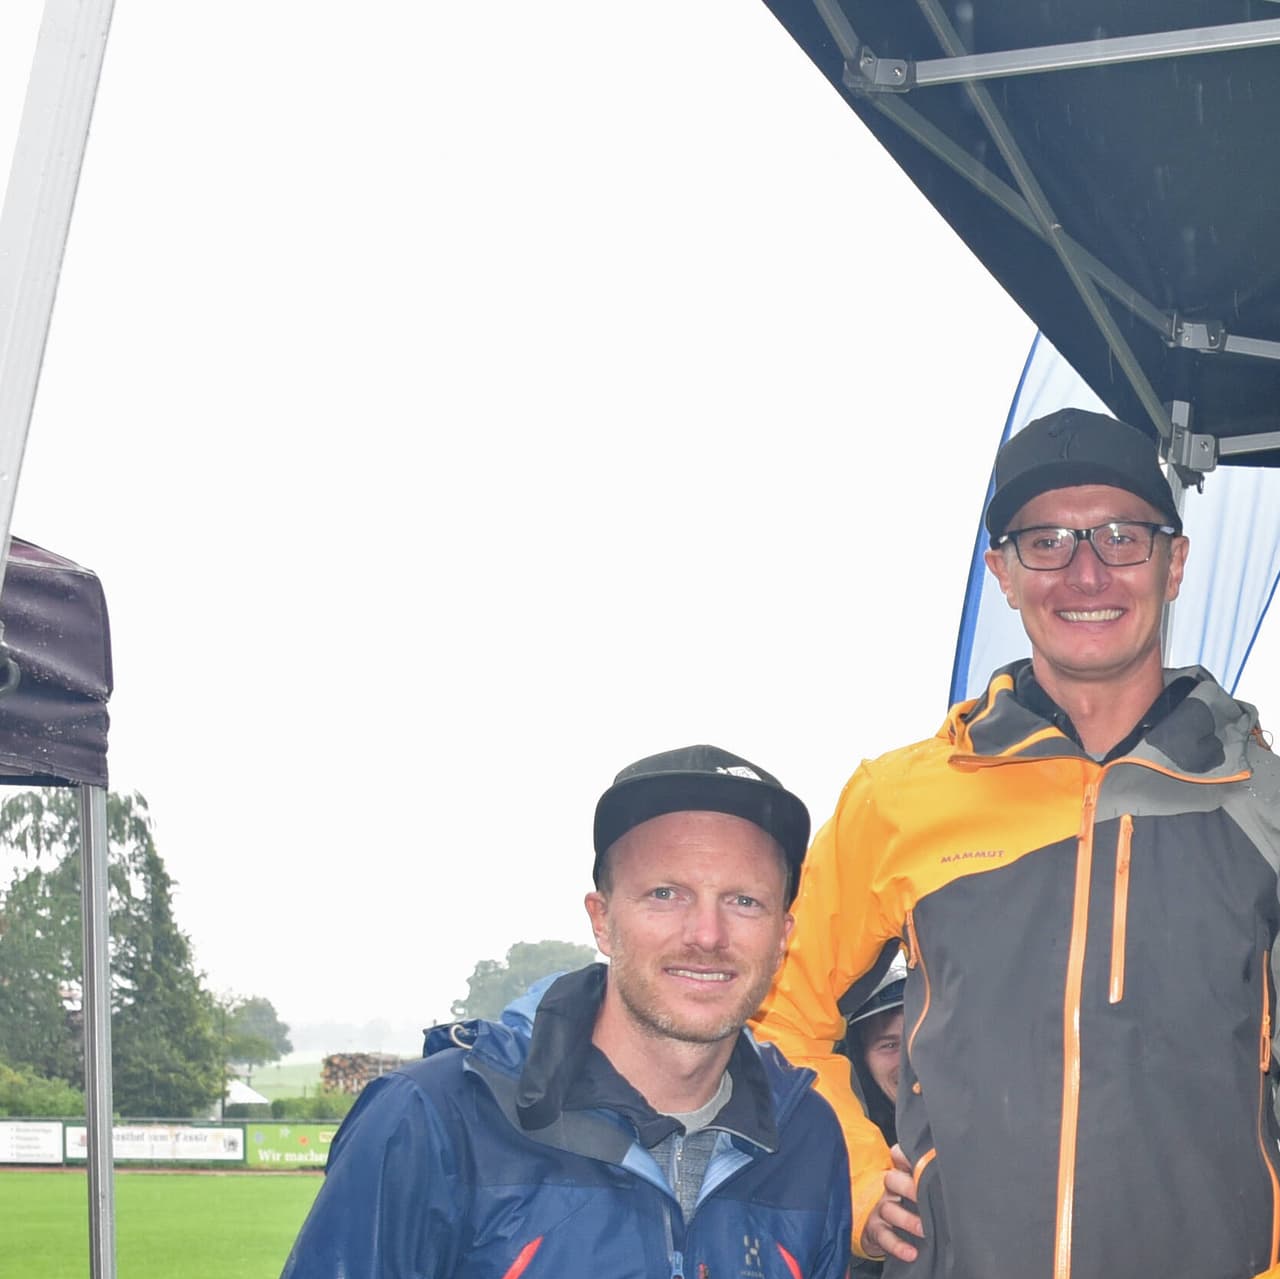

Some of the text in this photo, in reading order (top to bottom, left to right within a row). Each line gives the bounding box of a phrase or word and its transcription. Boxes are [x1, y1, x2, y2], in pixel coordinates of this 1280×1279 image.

[940, 849, 1005, 864] MAMMUT
[257, 1149, 328, 1162] Wir mache
